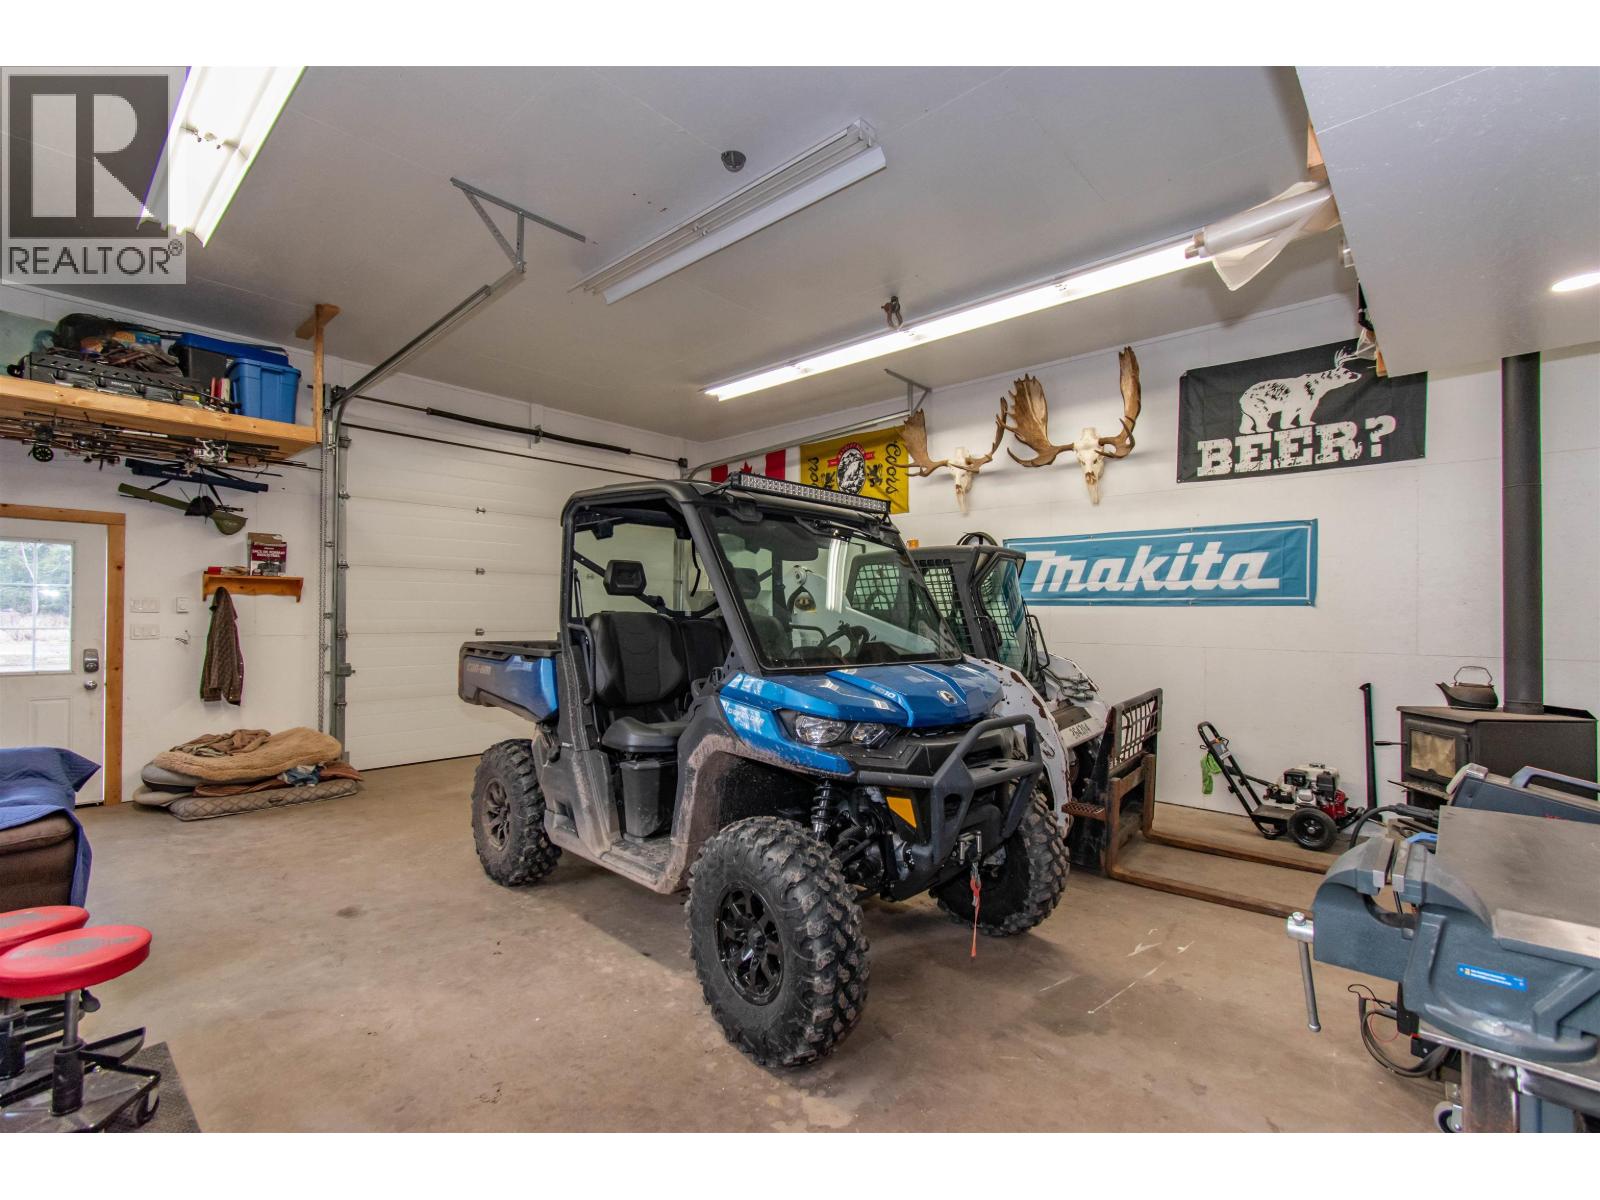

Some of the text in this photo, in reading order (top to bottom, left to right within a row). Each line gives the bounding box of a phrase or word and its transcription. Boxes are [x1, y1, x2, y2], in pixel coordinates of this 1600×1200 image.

[808, 456, 820, 486] ors
[885, 441, 902, 495] Coors
[1196, 414, 1396, 477] BEER?
